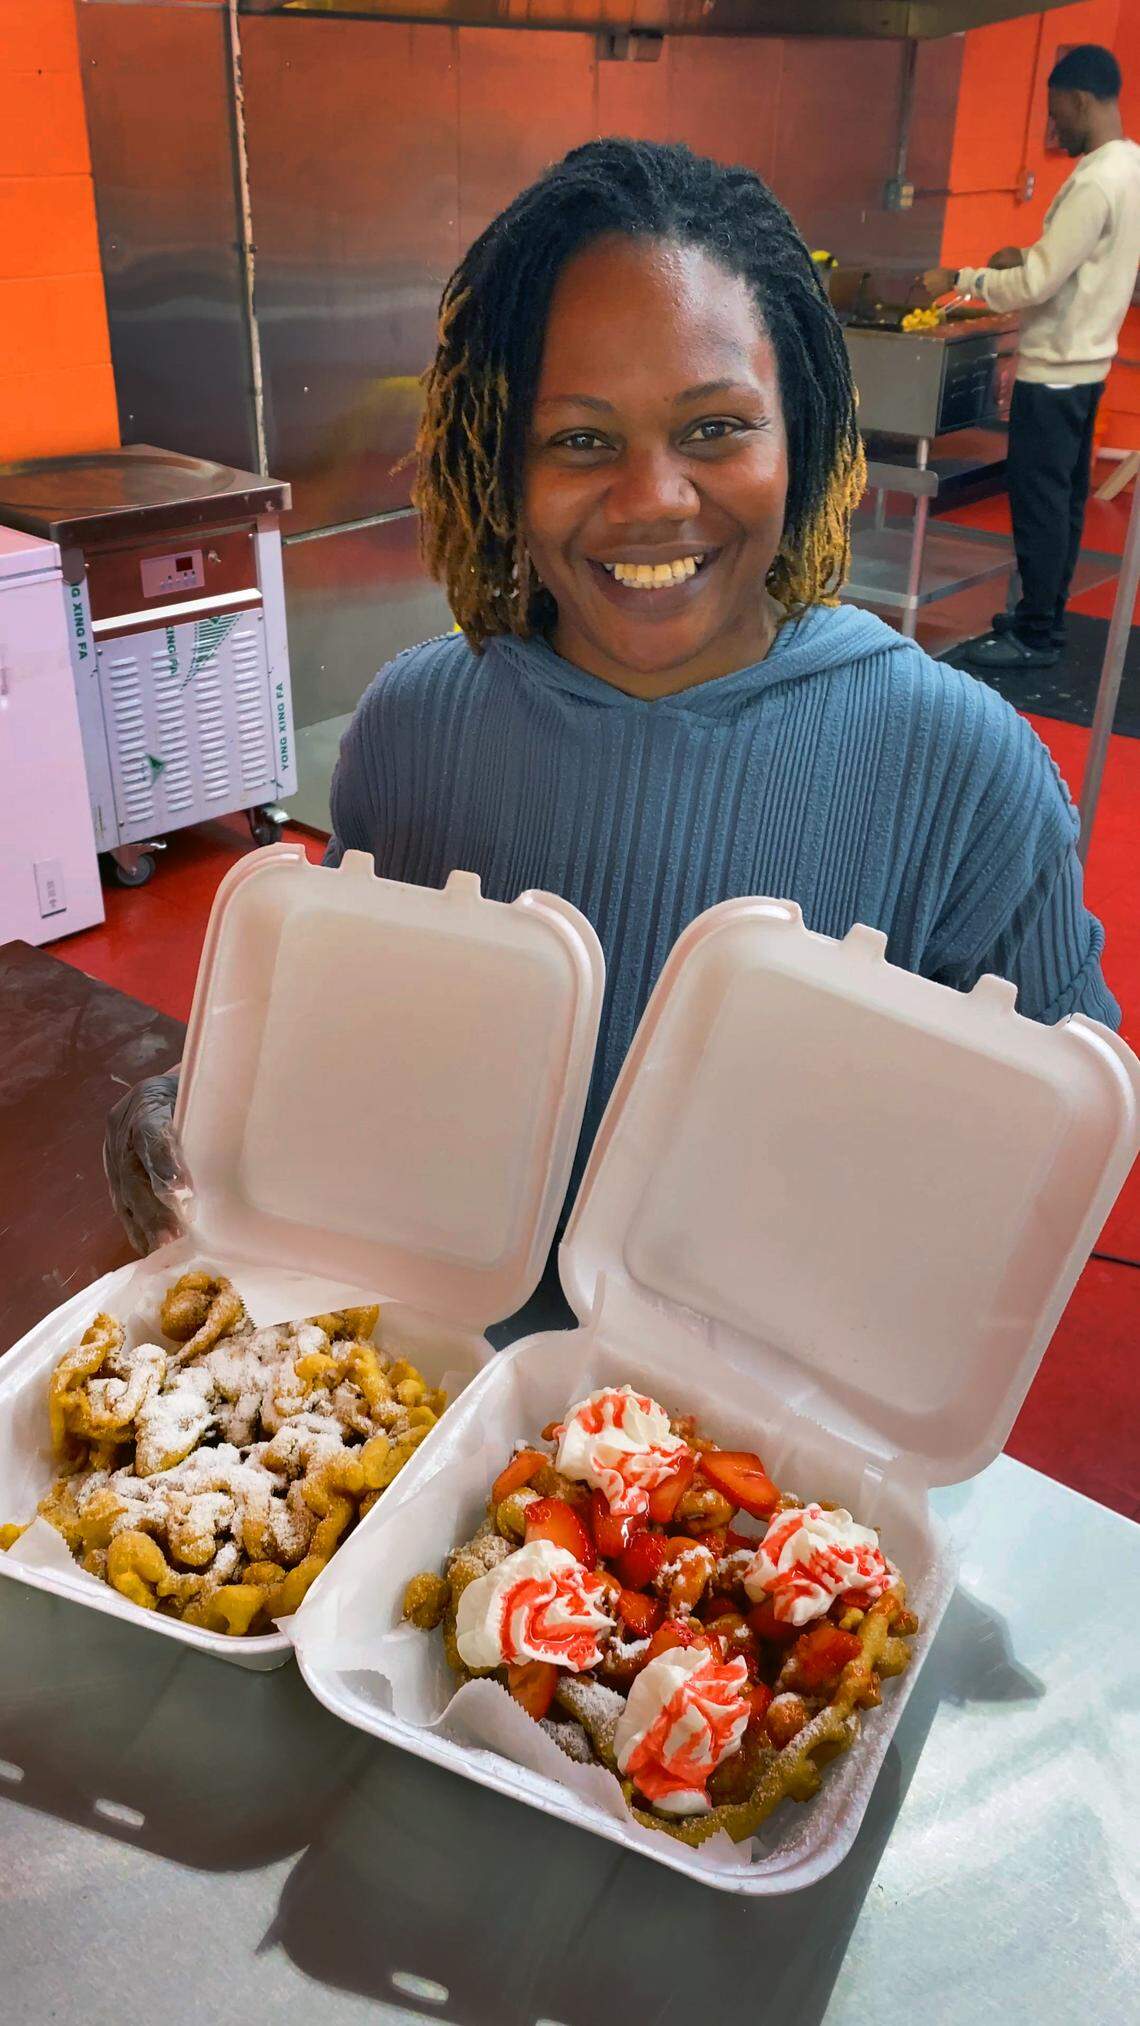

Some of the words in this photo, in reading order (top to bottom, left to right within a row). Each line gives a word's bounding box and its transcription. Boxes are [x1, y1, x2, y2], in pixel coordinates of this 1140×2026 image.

[73, 602, 86, 638] XING
[78, 641, 89, 660] FA
[275, 682, 284, 699] FA
[277, 702, 286, 733] XING
[280, 736, 289, 771] YONG
